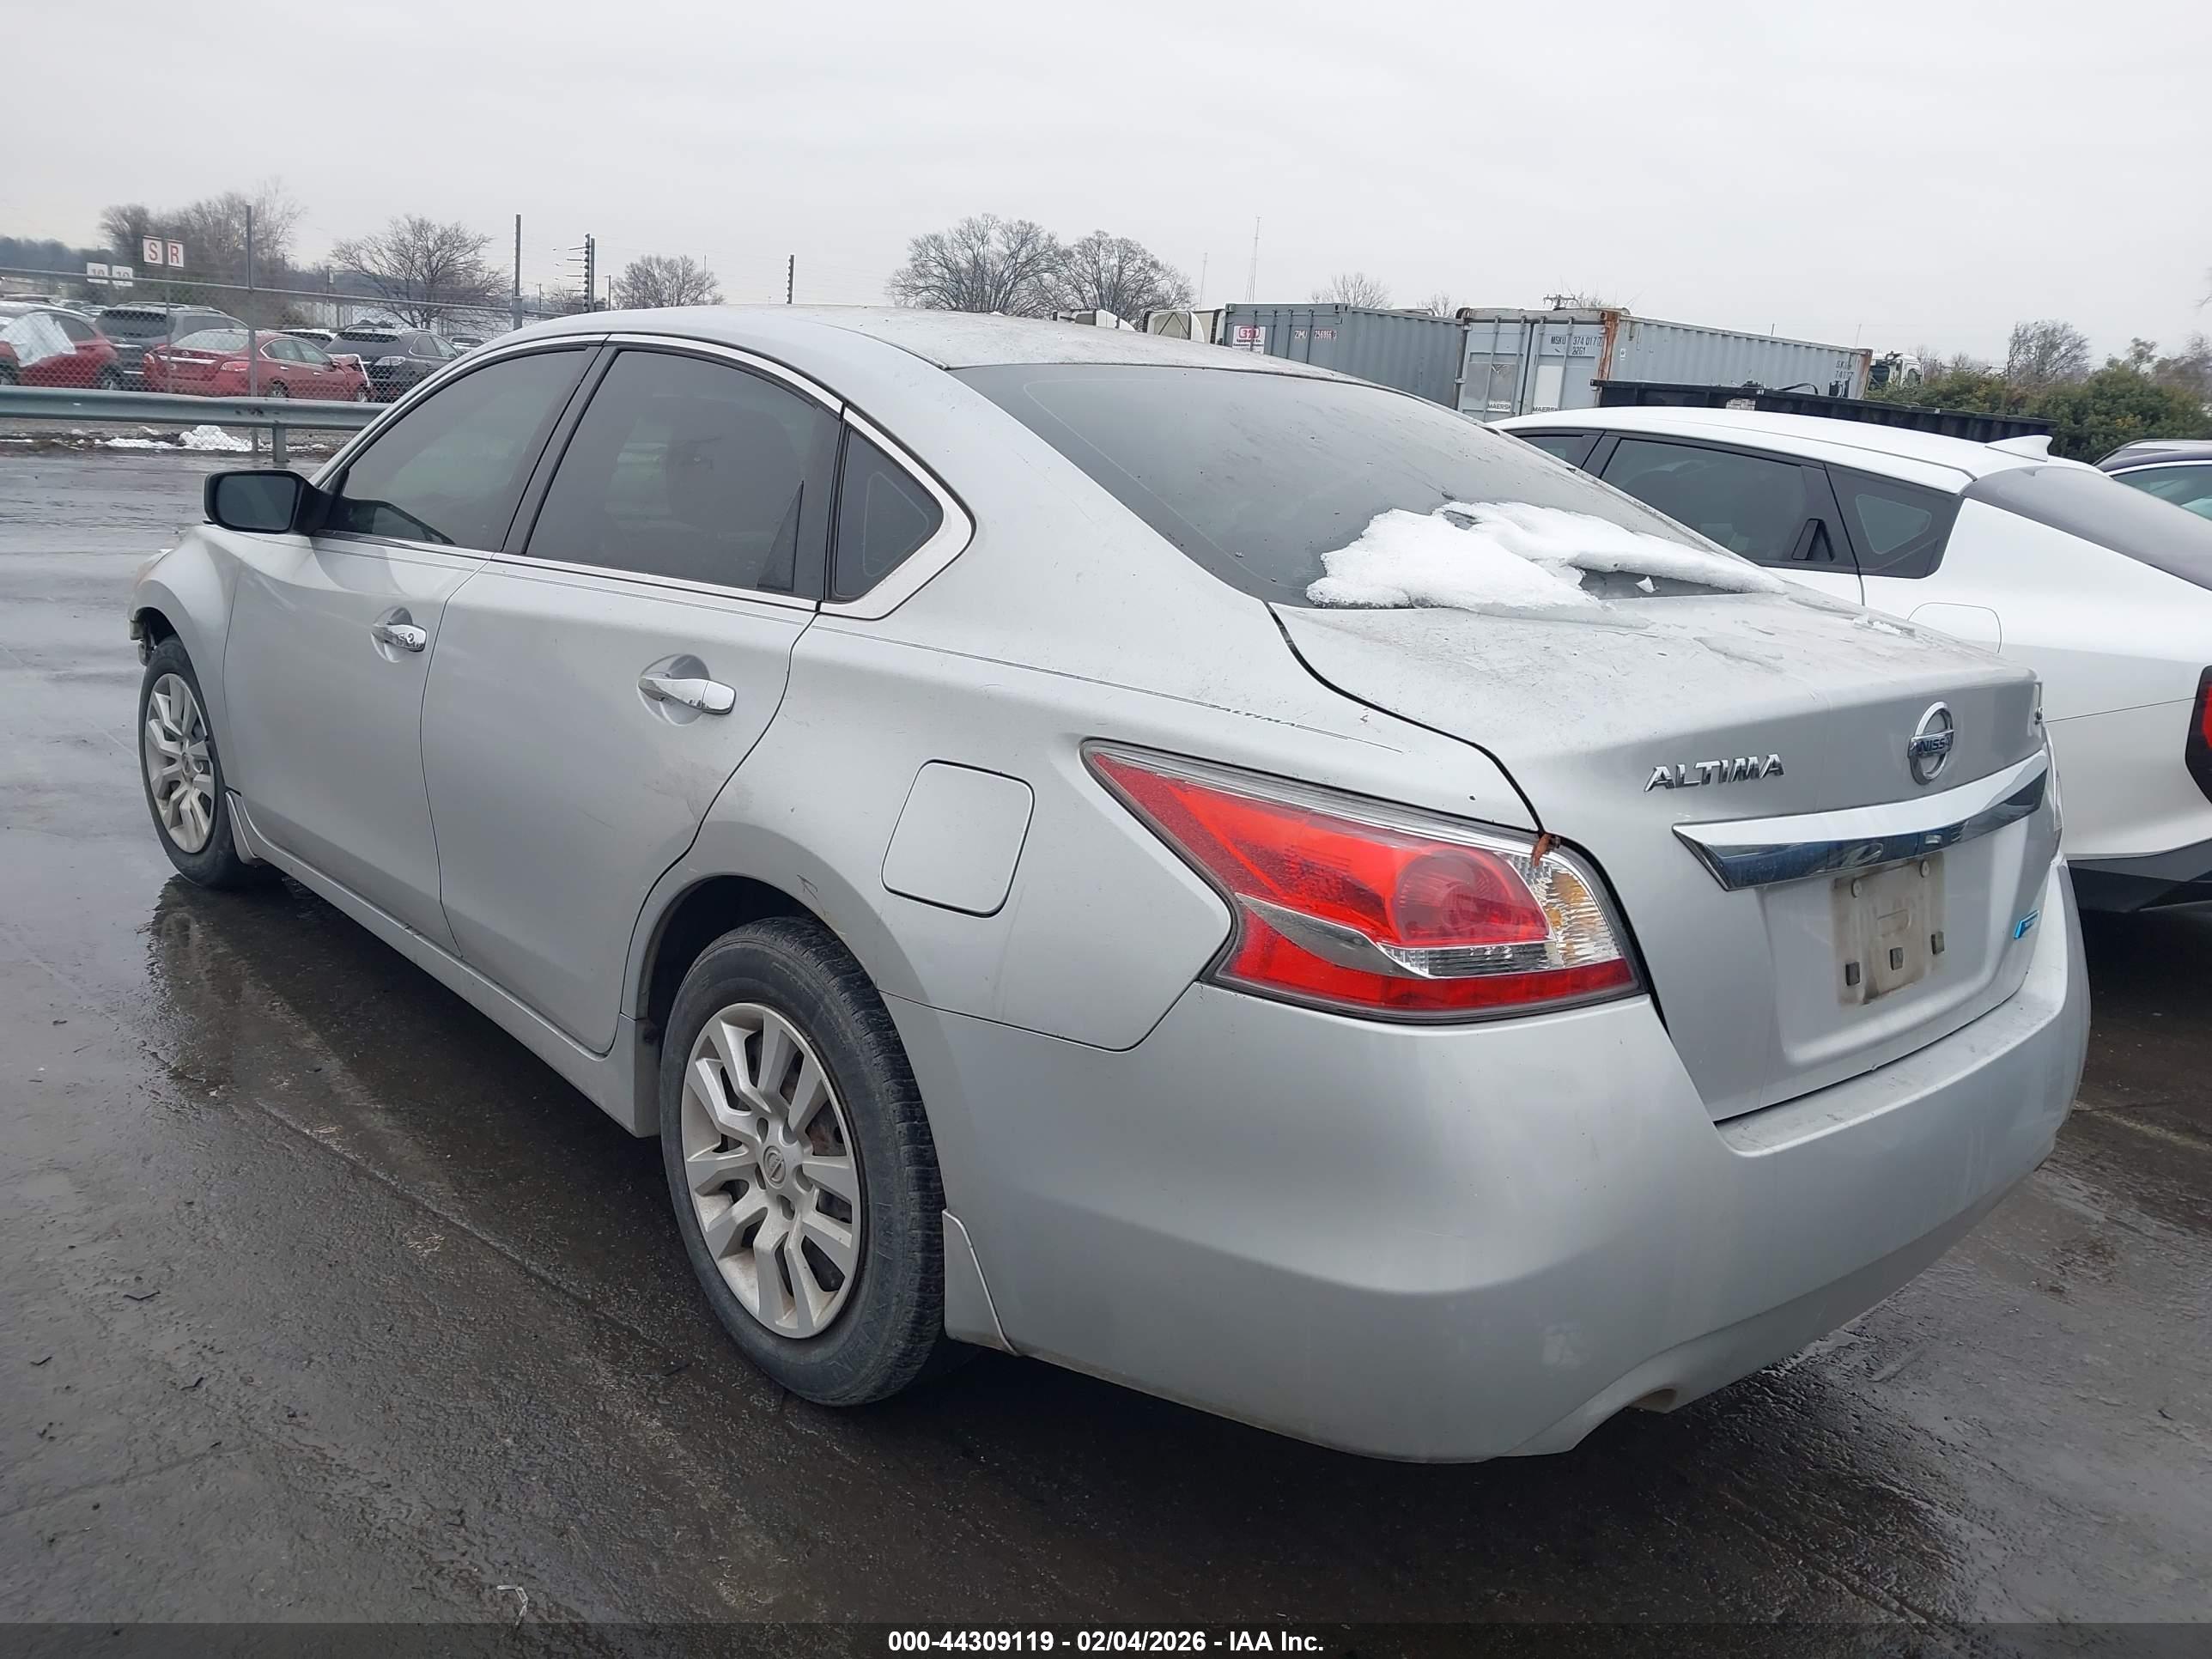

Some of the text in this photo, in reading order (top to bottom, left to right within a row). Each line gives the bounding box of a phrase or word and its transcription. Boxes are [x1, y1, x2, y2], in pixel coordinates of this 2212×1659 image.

[149, 242, 158, 261] S
[170, 245, 179, 264] R
[1550, 336, 1566, 345] MSKU
[1644, 753, 1784, 793] ALTIMA
